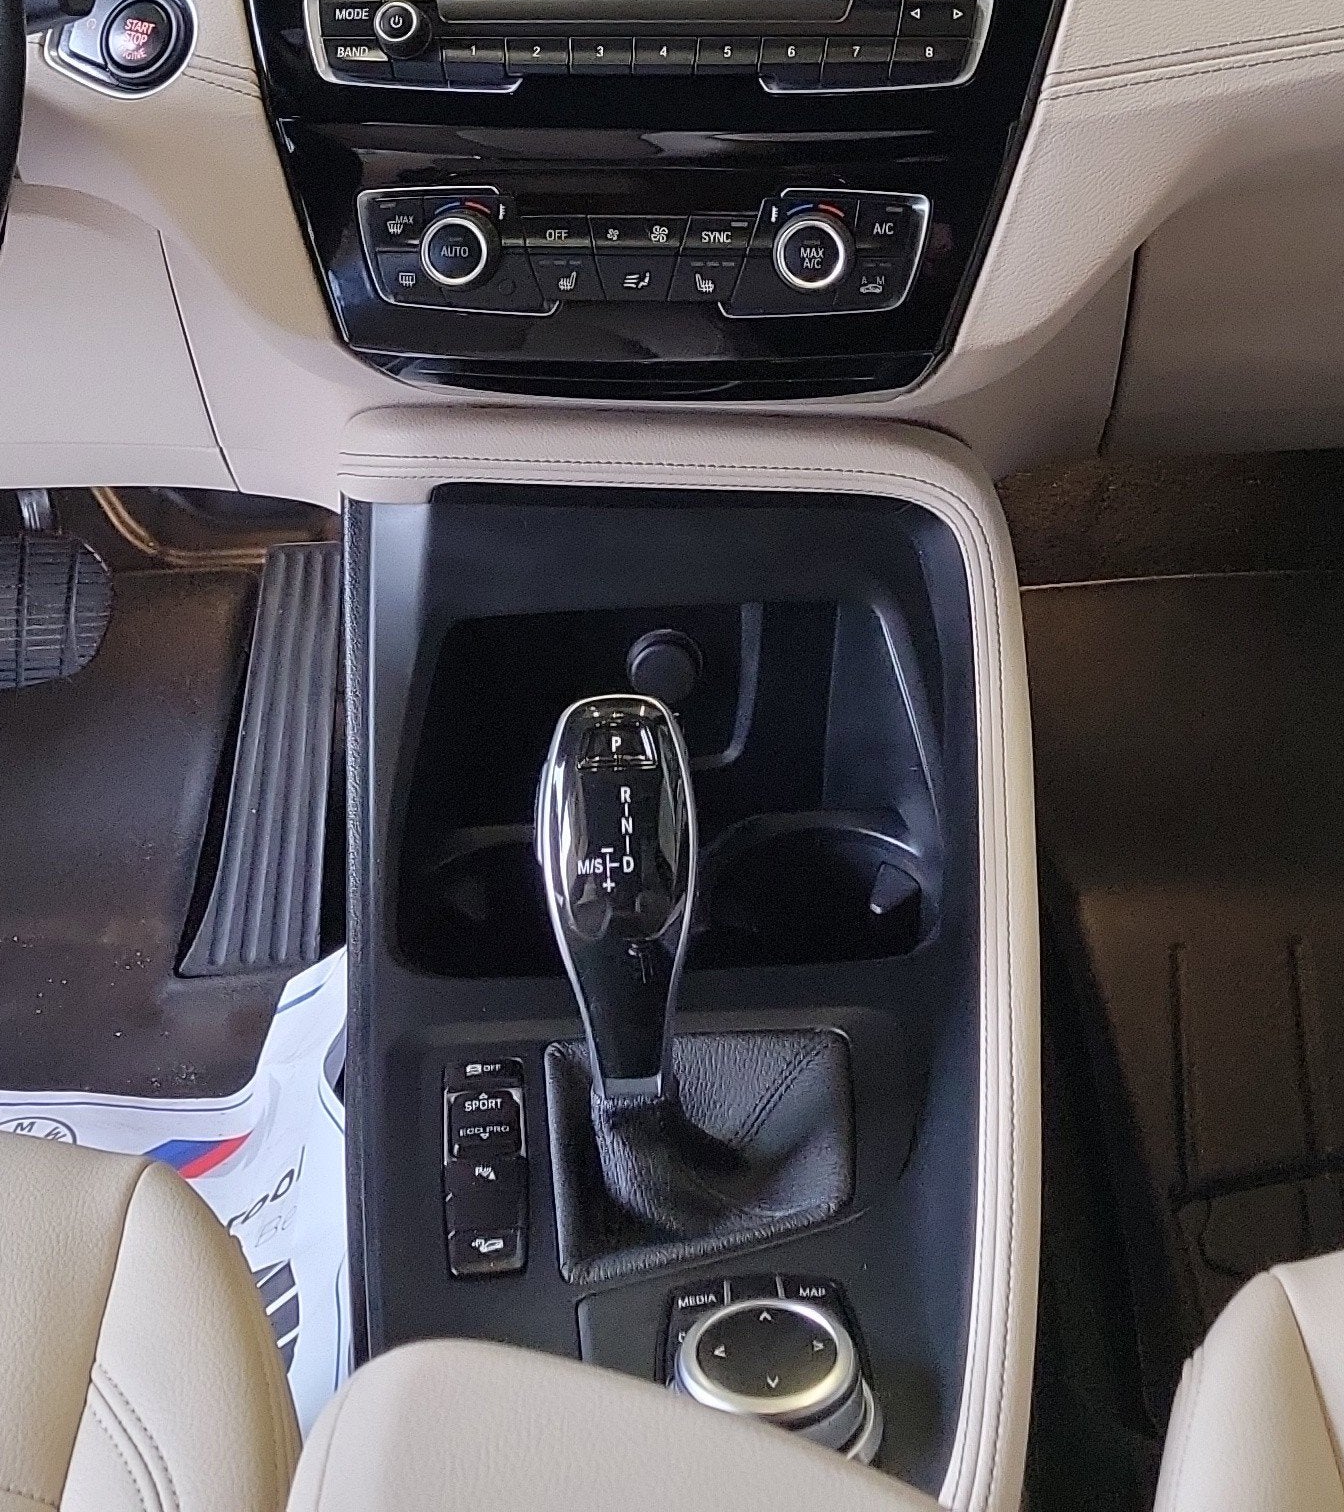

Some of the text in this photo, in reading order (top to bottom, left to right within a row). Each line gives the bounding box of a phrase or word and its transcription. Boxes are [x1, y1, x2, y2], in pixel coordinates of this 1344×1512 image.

[334, 8, 369, 21] MODE
[124, 18, 156, 35] START
[123, 31, 148, 46] STOP
[337, 46, 368, 58] BAND
[470, 45, 934, 59] 1 2 3 4 5 6 7 8
[395, 215, 414, 225] MAX
[873, 222, 894, 235] A/C
[545, 229, 569, 242] OFF
[701, 231, 732, 244] SYNC
[440, 245, 469, 258] AUTO
[800, 247, 824, 259] MAX
[803, 257, 822, 270] A/C
[611, 736, 622, 753] P
[620, 786, 632, 804] R
[621, 817, 633, 835] N
[577, 856, 635, 876] M/S D
[464, 1098, 503, 1112] SPORT
[799, 1286, 827, 1298] MAP
[678, 1293, 717, 1309] MEDIA
